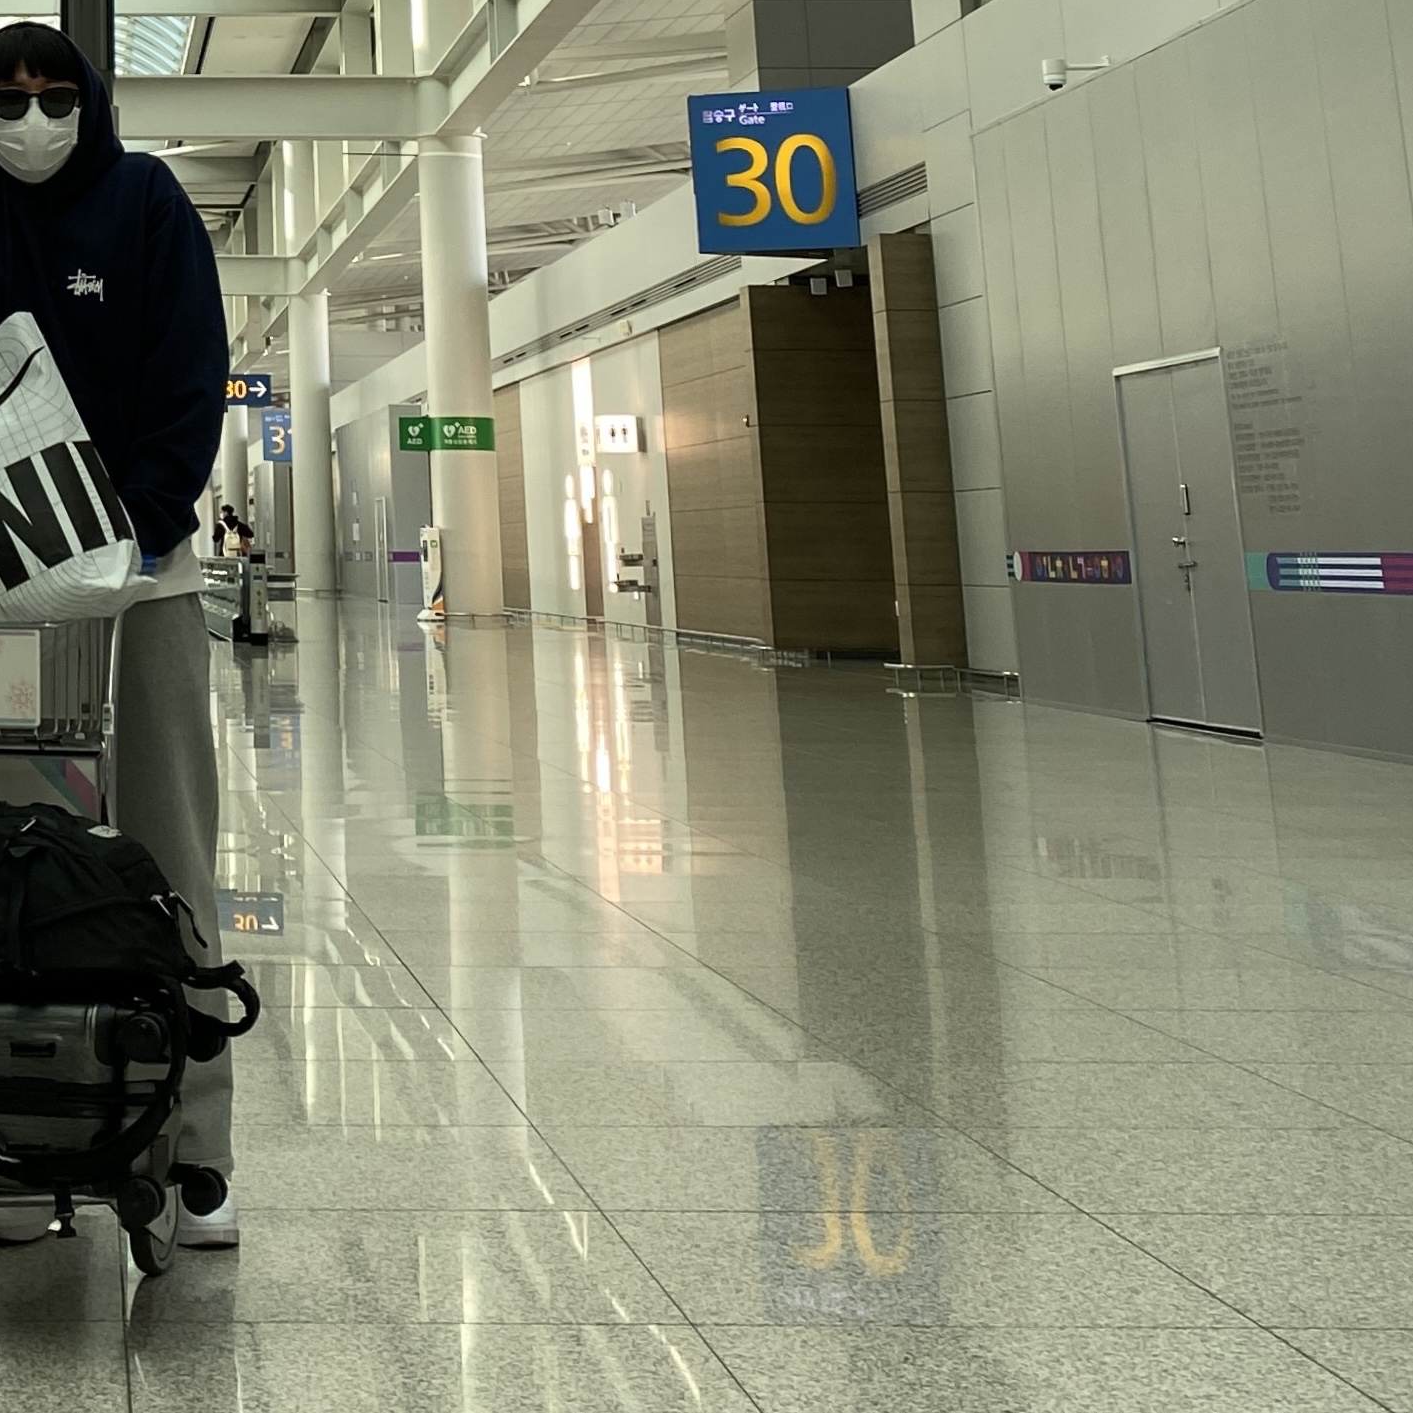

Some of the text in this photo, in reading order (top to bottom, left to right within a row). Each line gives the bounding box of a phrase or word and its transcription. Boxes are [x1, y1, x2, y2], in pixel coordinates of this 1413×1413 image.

[738, 115, 766, 126] Gate
[715, 133, 837, 227] 30
[226, 380, 247, 399] 30
[457, 425, 477, 435] AED
